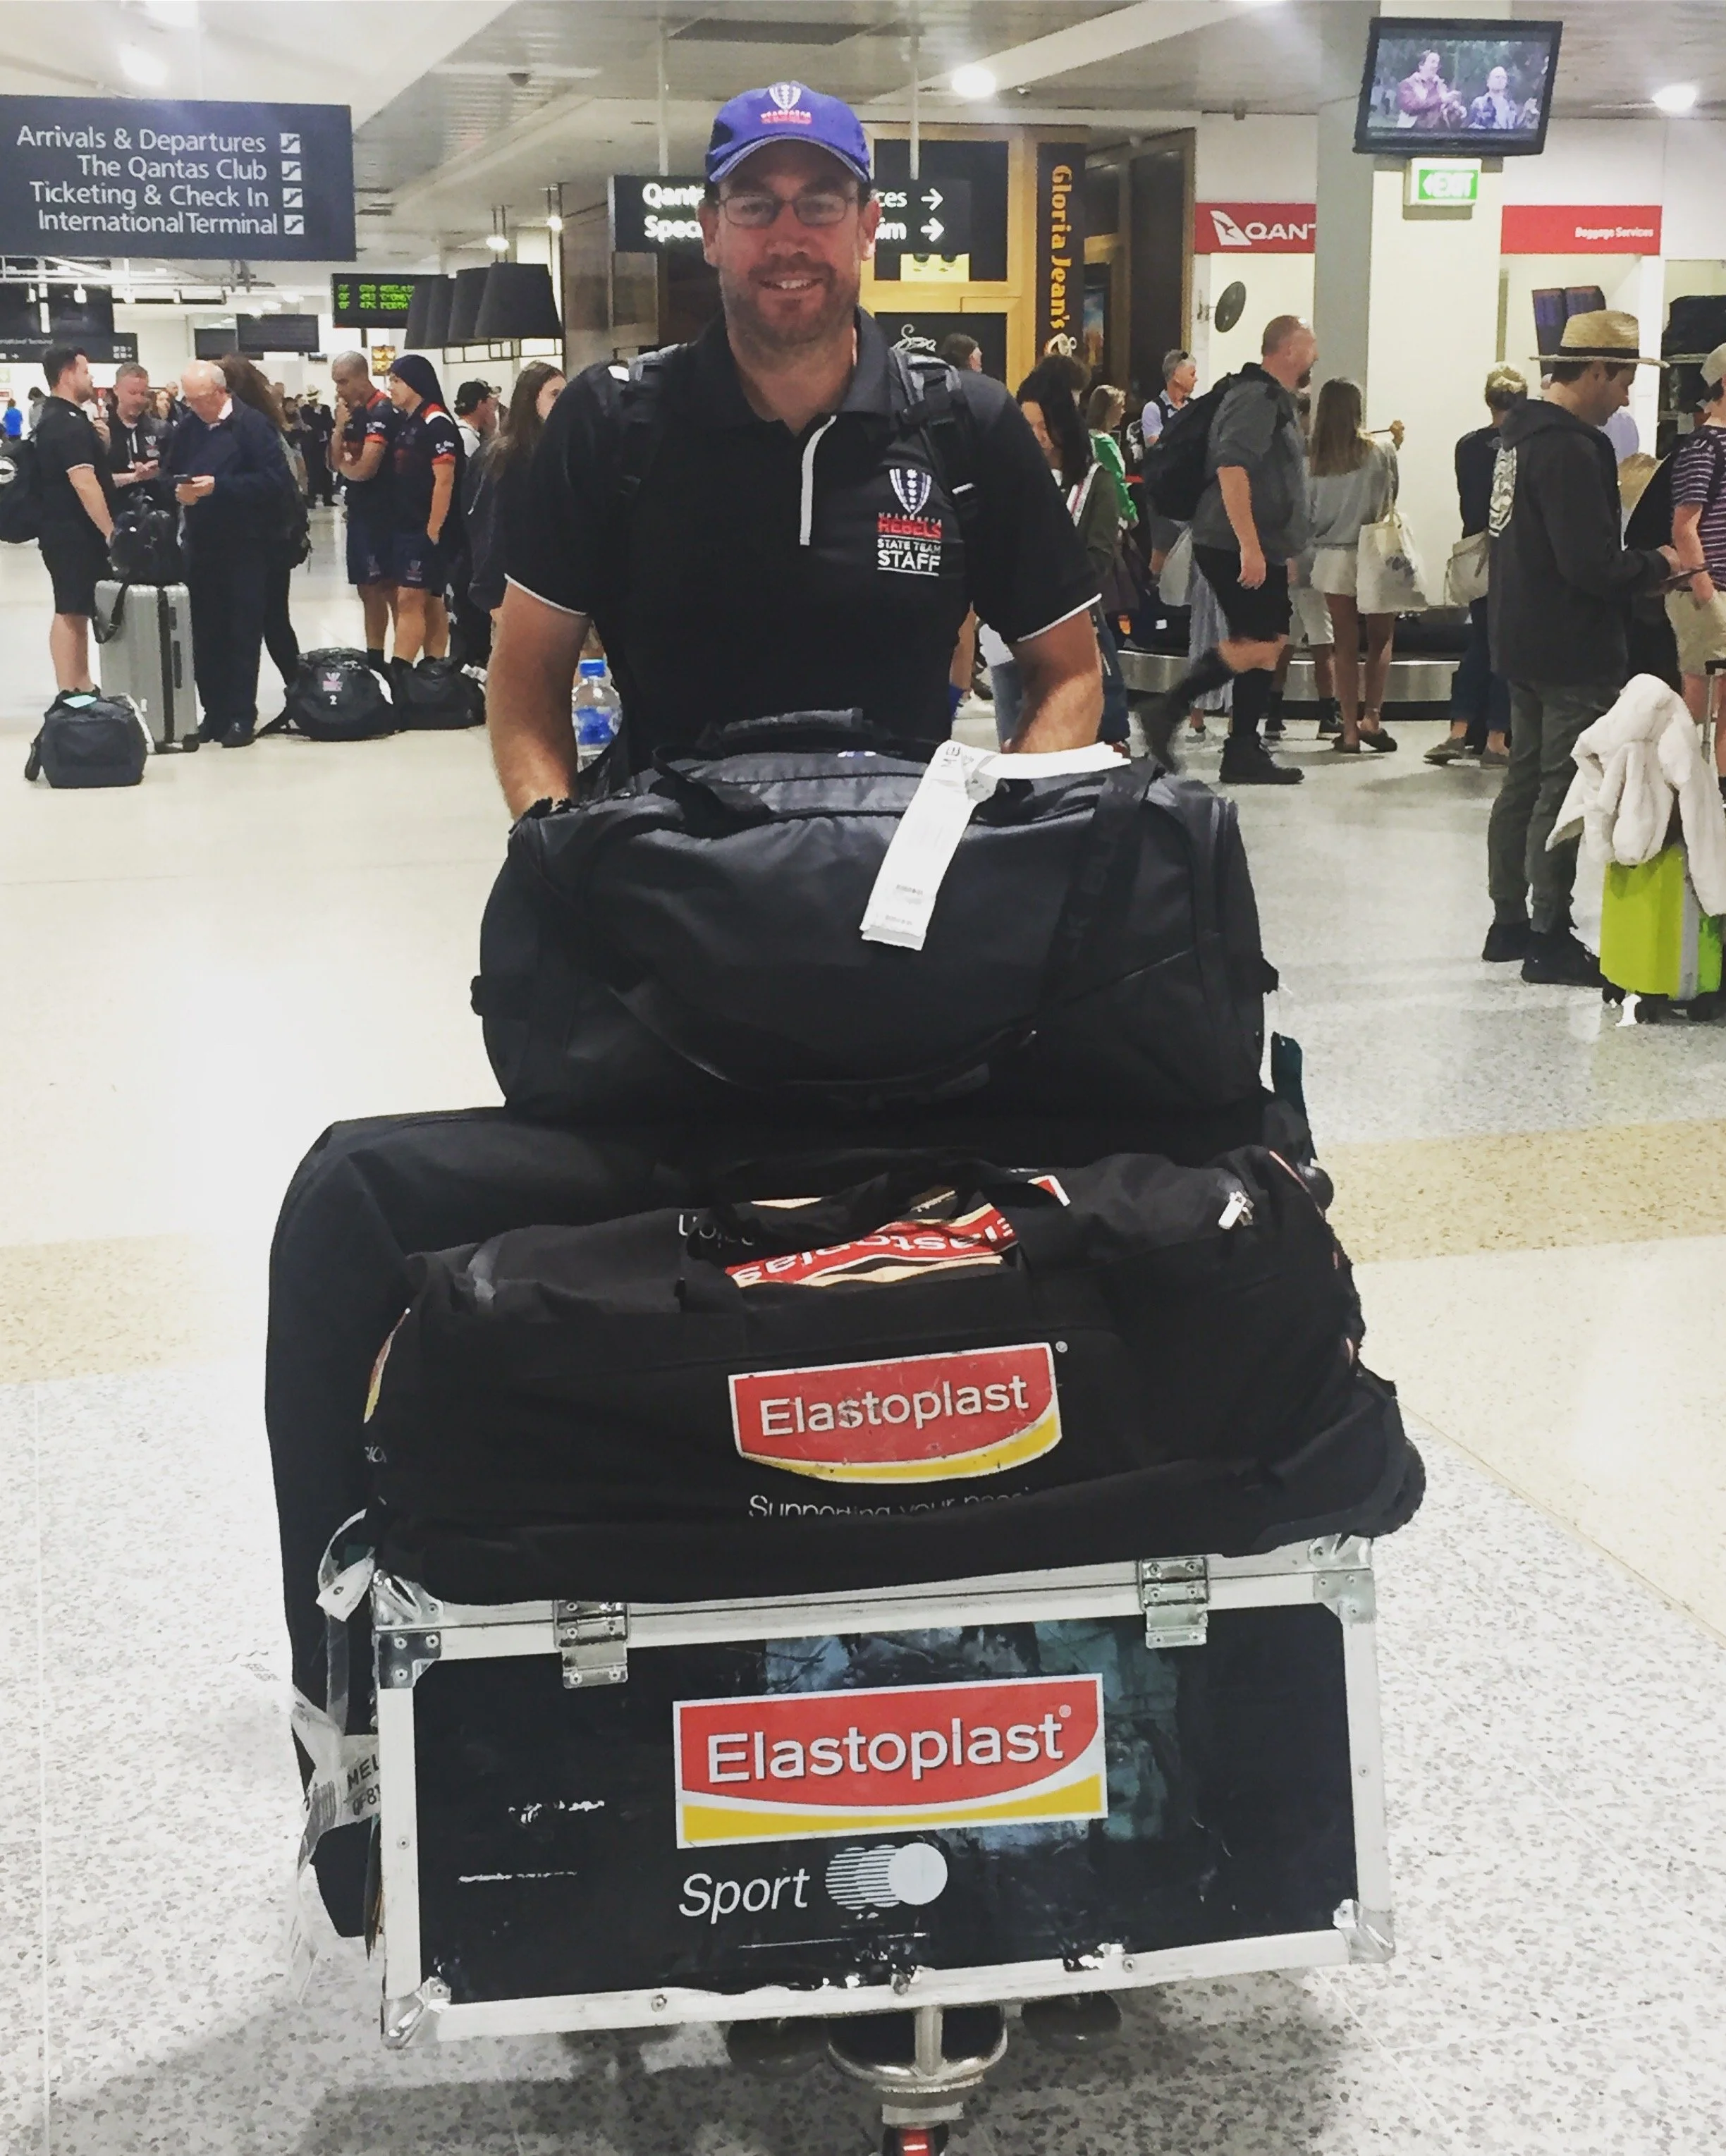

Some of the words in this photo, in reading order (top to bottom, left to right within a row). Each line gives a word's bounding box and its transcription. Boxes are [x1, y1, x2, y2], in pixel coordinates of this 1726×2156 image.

[17, 125, 106, 149] Arrivals
[114, 128, 132, 149] &
[140, 129, 267, 156] Departures
[77, 154, 121, 177] The
[128, 156, 209, 181] Qantas
[216, 158, 267, 180] Club
[30, 181, 136, 209] Ticketing
[144, 185, 162, 205] &
[170, 184, 240, 207] Check
[248, 188, 269, 207] In
[875, 191, 907, 208] ces
[1051, 165, 1072, 250] Gloria
[39, 210, 183, 233] International
[186, 212, 277, 235] Terminal
[875, 216, 907, 240] im
[1050, 255, 1072, 329] Jean's
[877, 539, 911, 551] STATE
[913, 541, 942, 555] TEAM
[877, 549, 941, 572] STAFF
[759, 1376, 1029, 1436] Elastoplast
[708, 1713, 1064, 1784] Elastoplast
[678, 1868, 810, 1925] Sport
